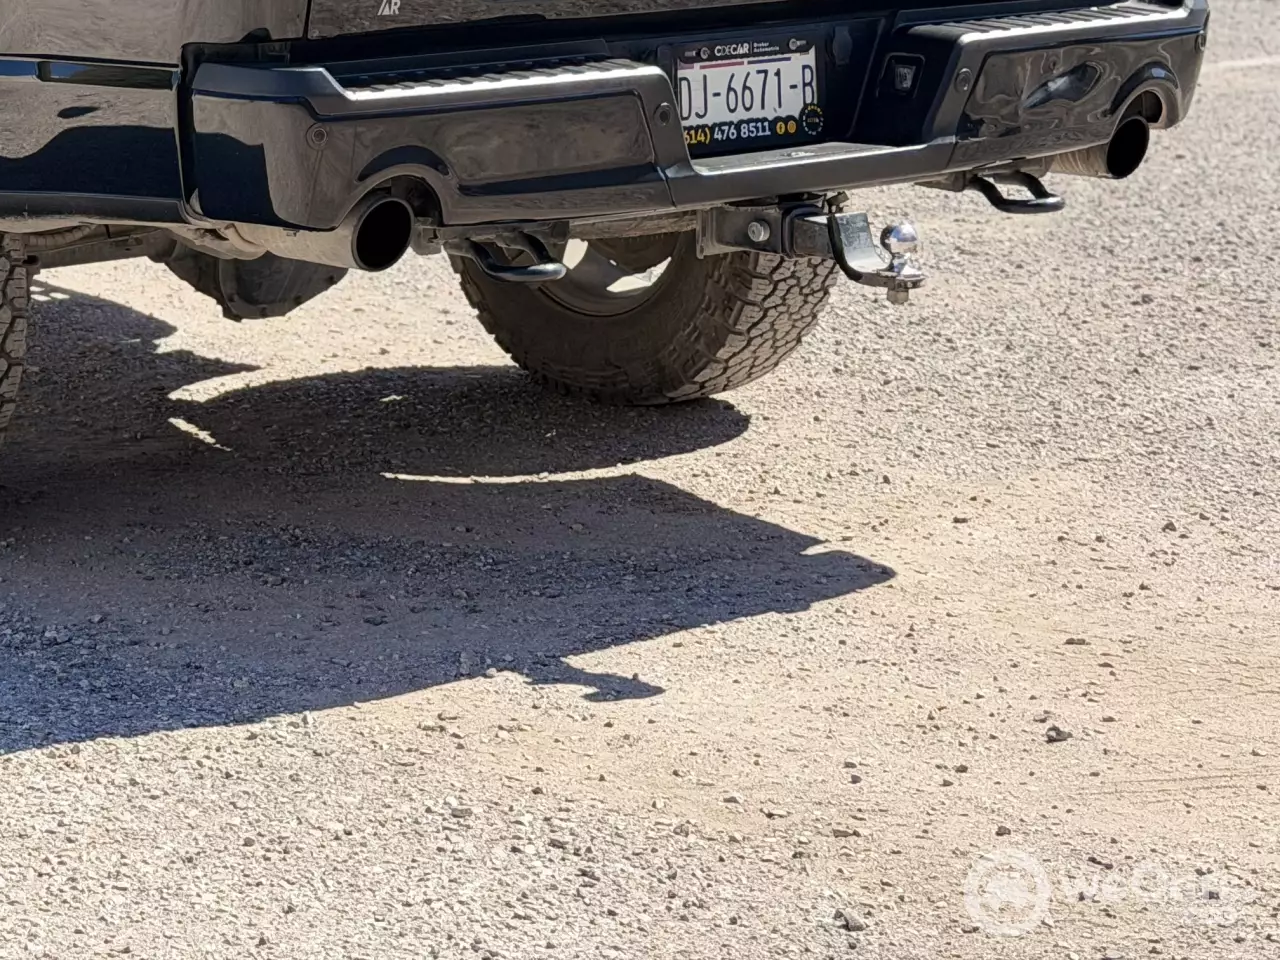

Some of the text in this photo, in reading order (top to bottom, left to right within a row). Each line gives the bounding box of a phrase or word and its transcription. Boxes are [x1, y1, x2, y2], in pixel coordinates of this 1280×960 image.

[714, 42, 750, 57] CDECAR
[678, 64, 815, 122] DJ-6671-B
[713, 124, 737, 140] 476
[740, 121, 771, 138] 8511
